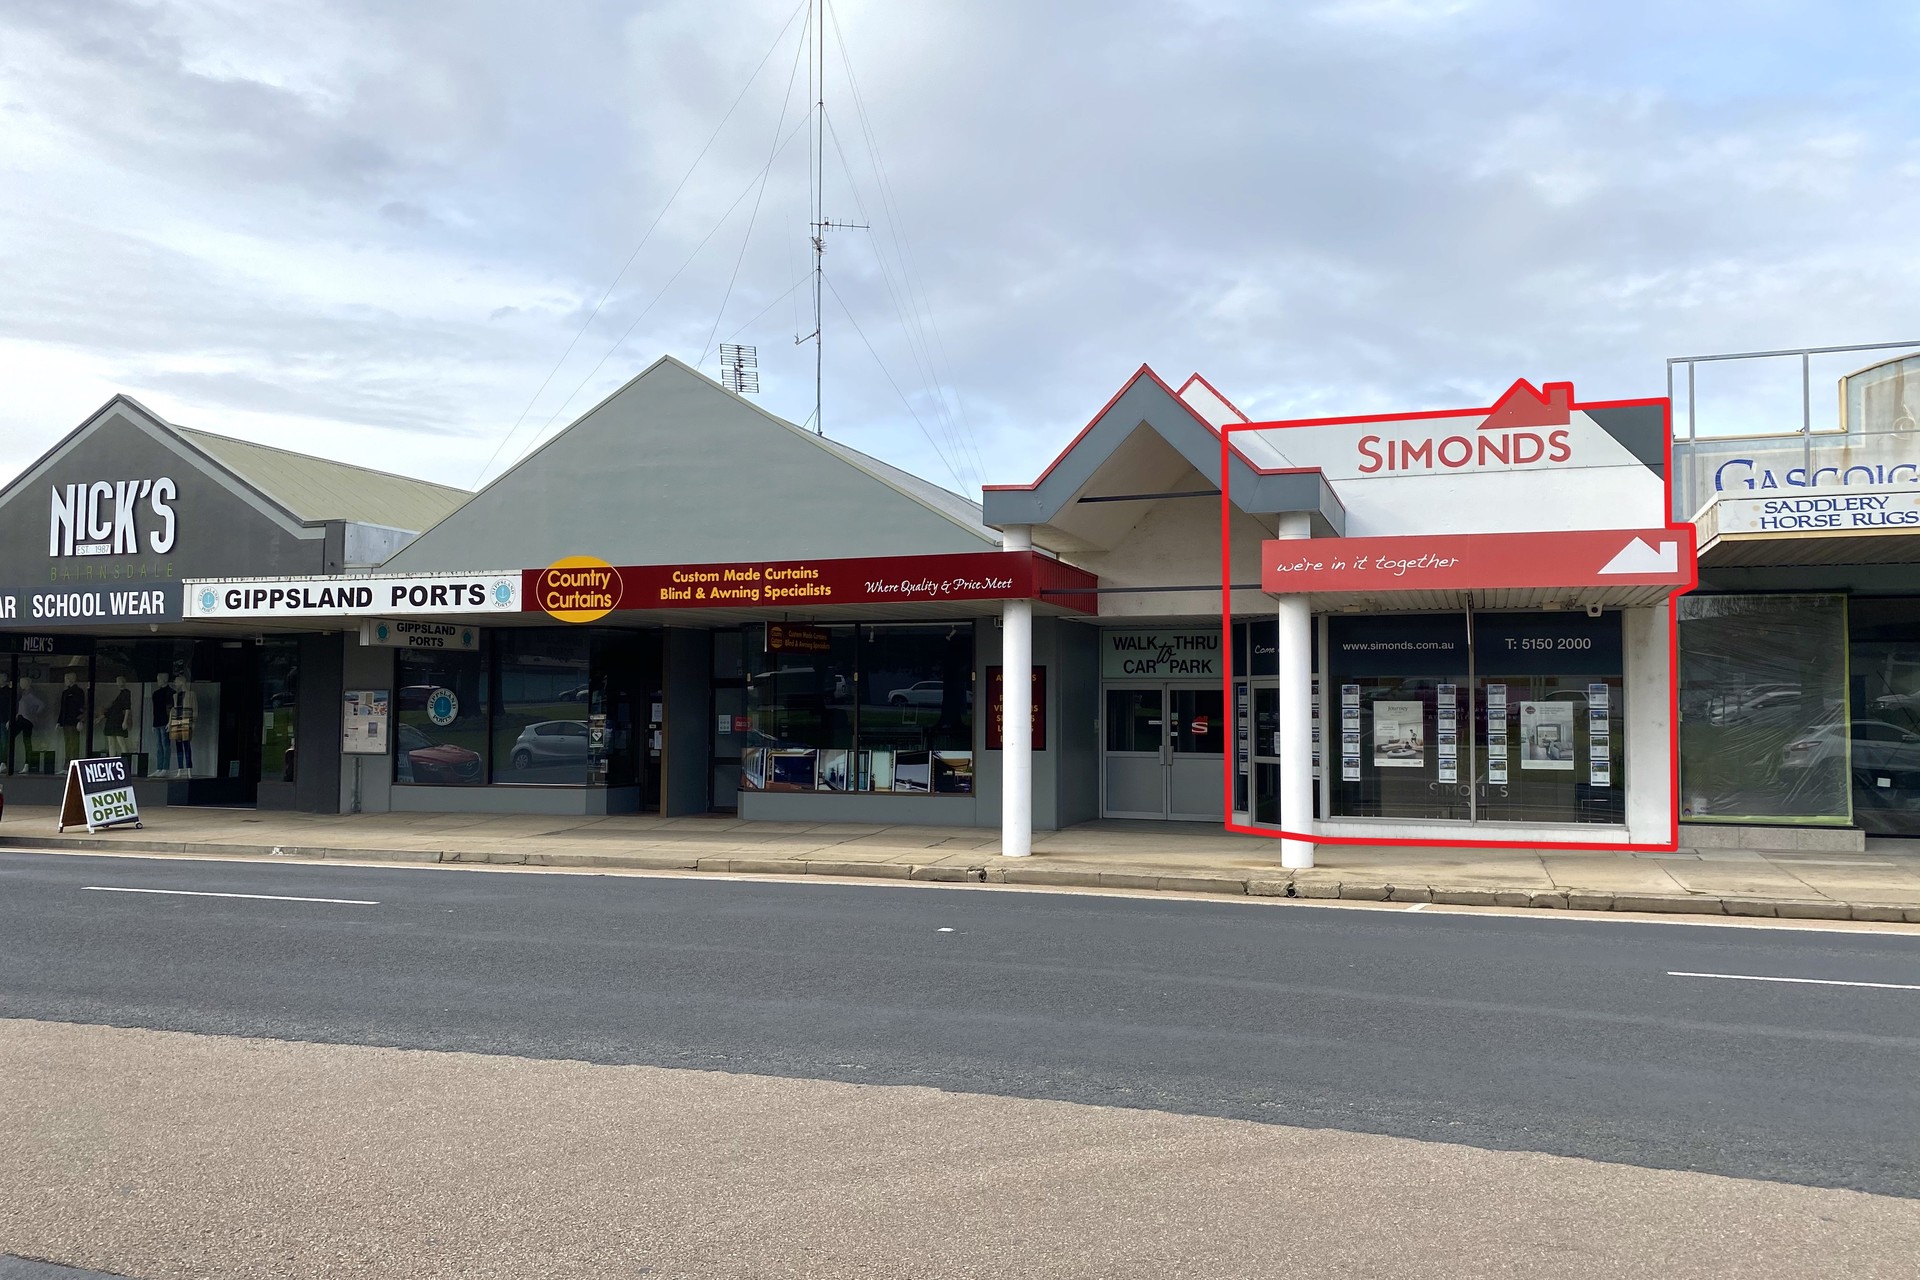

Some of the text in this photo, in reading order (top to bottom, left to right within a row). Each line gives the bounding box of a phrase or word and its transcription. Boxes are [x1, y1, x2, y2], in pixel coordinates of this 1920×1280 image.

[1358, 430, 1571, 473] SIMONDS
[1764, 495, 1890, 515] SADDLERY
[50, 477, 176, 557] NICK'S
[1760, 511, 1919, 530] HORSE RUGS
[95, 545, 110, 553] 1987
[50, 562, 173, 581] BAIRNSDALE
[1277, 553, 1459, 576] we're in it together
[547, 569, 611, 590] Country
[672, 566, 819, 583] Custom Made Curtains
[660, 582, 832, 601] Blind & Awning Specialists
[864, 577, 1013, 596] Where Quality & Price Meet
[32, 590, 165, 618] SCHOOL WEAR
[225, 583, 486, 610] GIPPSLAND PORTS
[546, 591, 612, 609] Curtains
[396, 622, 456, 636] GIPPSLAND
[23, 636, 54, 652] NICK'S
[408, 635, 444, 647] PORTS
[1112, 635, 1218, 651] WALK THRU
[1254, 645, 1275, 654] Come
[1342, 641, 1455, 651] www.simonds.com.au
[1504, 638, 1592, 650] T: 5150 2000
[1156, 641, 1177, 664] to
[1123, 659, 1213, 674] CAR PARK
[1191, 721, 1208, 733] S
[84, 761, 126, 783] NICK'S
[91, 790, 128, 808] NOW
[92, 803, 135, 822] OPEN
